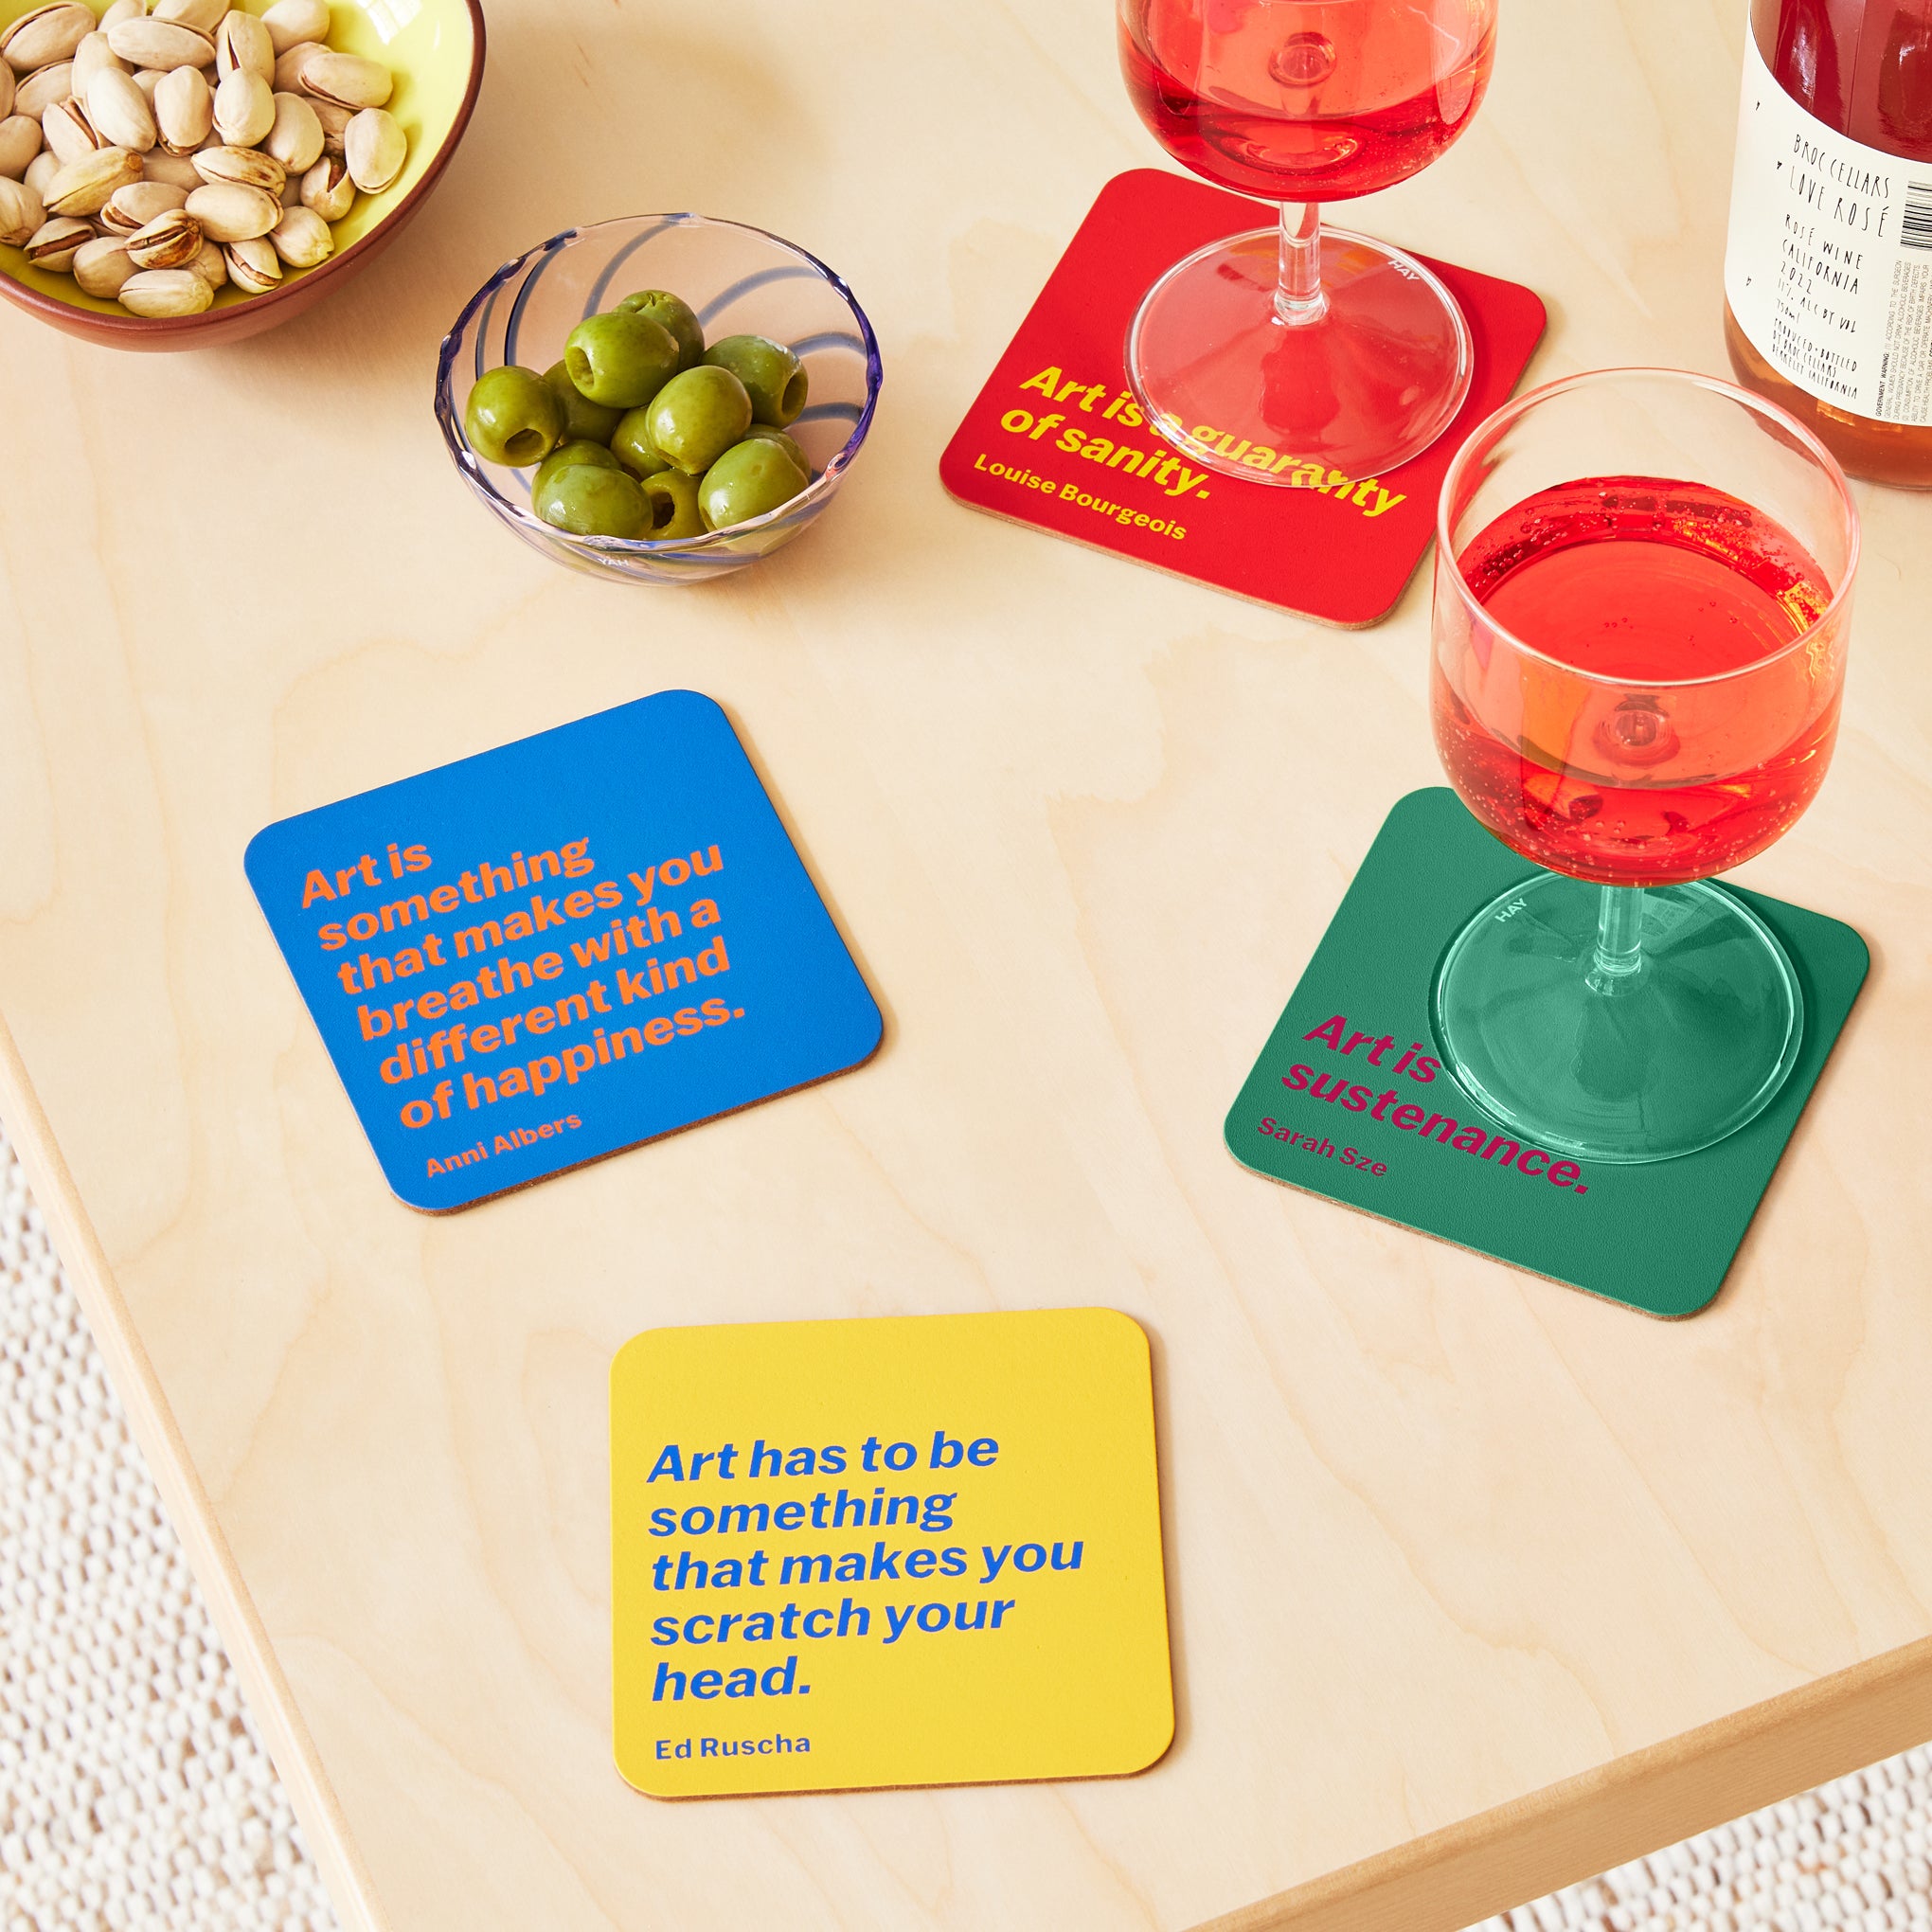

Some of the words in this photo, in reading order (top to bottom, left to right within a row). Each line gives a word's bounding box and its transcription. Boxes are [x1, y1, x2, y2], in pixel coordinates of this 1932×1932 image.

[1794, 134, 1825, 171] BROC
[1831, 159, 1889, 198] CELLARS
[1790, 166, 1825, 210] LOVE
[1834, 197, 1889, 237] ROSÉ
[1387, 259, 1420, 280] HAY
[1783, 240, 1858, 295] CALIFORNIA
[1785, 214, 1815, 245] ROSÉ
[1823, 241, 1863, 269] WINE
[1781, 261, 1812, 295] 2022
[1800, 297, 1817, 314] ALC
[1839, 317, 1855, 332] VOL
[1876, 382, 1886, 416] GOVERNMENT
[1893, 259, 1902, 285] SURGEON
[1804, 353, 1836, 377] CELLARS
[1809, 370, 1857, 399] CALIFORNIA
[1820, 349, 1857, 372] BOTTLED
[1000, 409, 1066, 440] of
[1055, 428, 1210, 500] sanity.
[1019, 366, 1106, 413] Art
[1101, 390, 1145, 427] is
[1183, 424, 1407, 517] guaranty
[974, 454, 1057, 494] Louise
[1058, 483, 1187, 540] Bourgeois
[302, 854, 381, 909] Art
[386, 843, 432, 879] is
[318, 837, 595, 951] something
[337, 933, 446, 994] that
[453, 881, 622, 958] makes
[628, 845, 723, 906] you
[1494, 898, 1527, 922] HAY
[357, 951, 564, 1041] breathe
[570, 906, 682, 968] with
[689, 899, 721, 928] a
[380, 980, 612, 1084] different
[616, 936, 730, 1005] kind
[400, 1080, 454, 1129] of
[461, 997, 745, 1110] happiness.
[1303, 1014, 1395, 1066] Art
[1391, 1042, 1441, 1083] is
[426, 1141, 488, 1177] Anni
[493, 1115, 582, 1154] Albers
[1256, 1116, 1336, 1158] Sarah
[1338, 1146, 1388, 1176] Sze
[1280, 1063, 1589, 1195] sustenance.
[647, 1445, 738, 1482] Art
[749, 1440, 847, 1477] has
[861, 1436, 918, 1472] to
[930, 1431, 999, 1469] be
[648, 1488, 957, 1536] something
[652, 1550, 769, 1591] that
[779, 1542, 968, 1584] makes
[979, 1541, 1083, 1583] you
[651, 1599, 870, 1646] scratch
[883, 1598, 1015, 1644] your
[653, 1657, 812, 1702] head.
[655, 1738, 692, 1760] Ed
[700, 1733, 812, 1758] Ruscha
